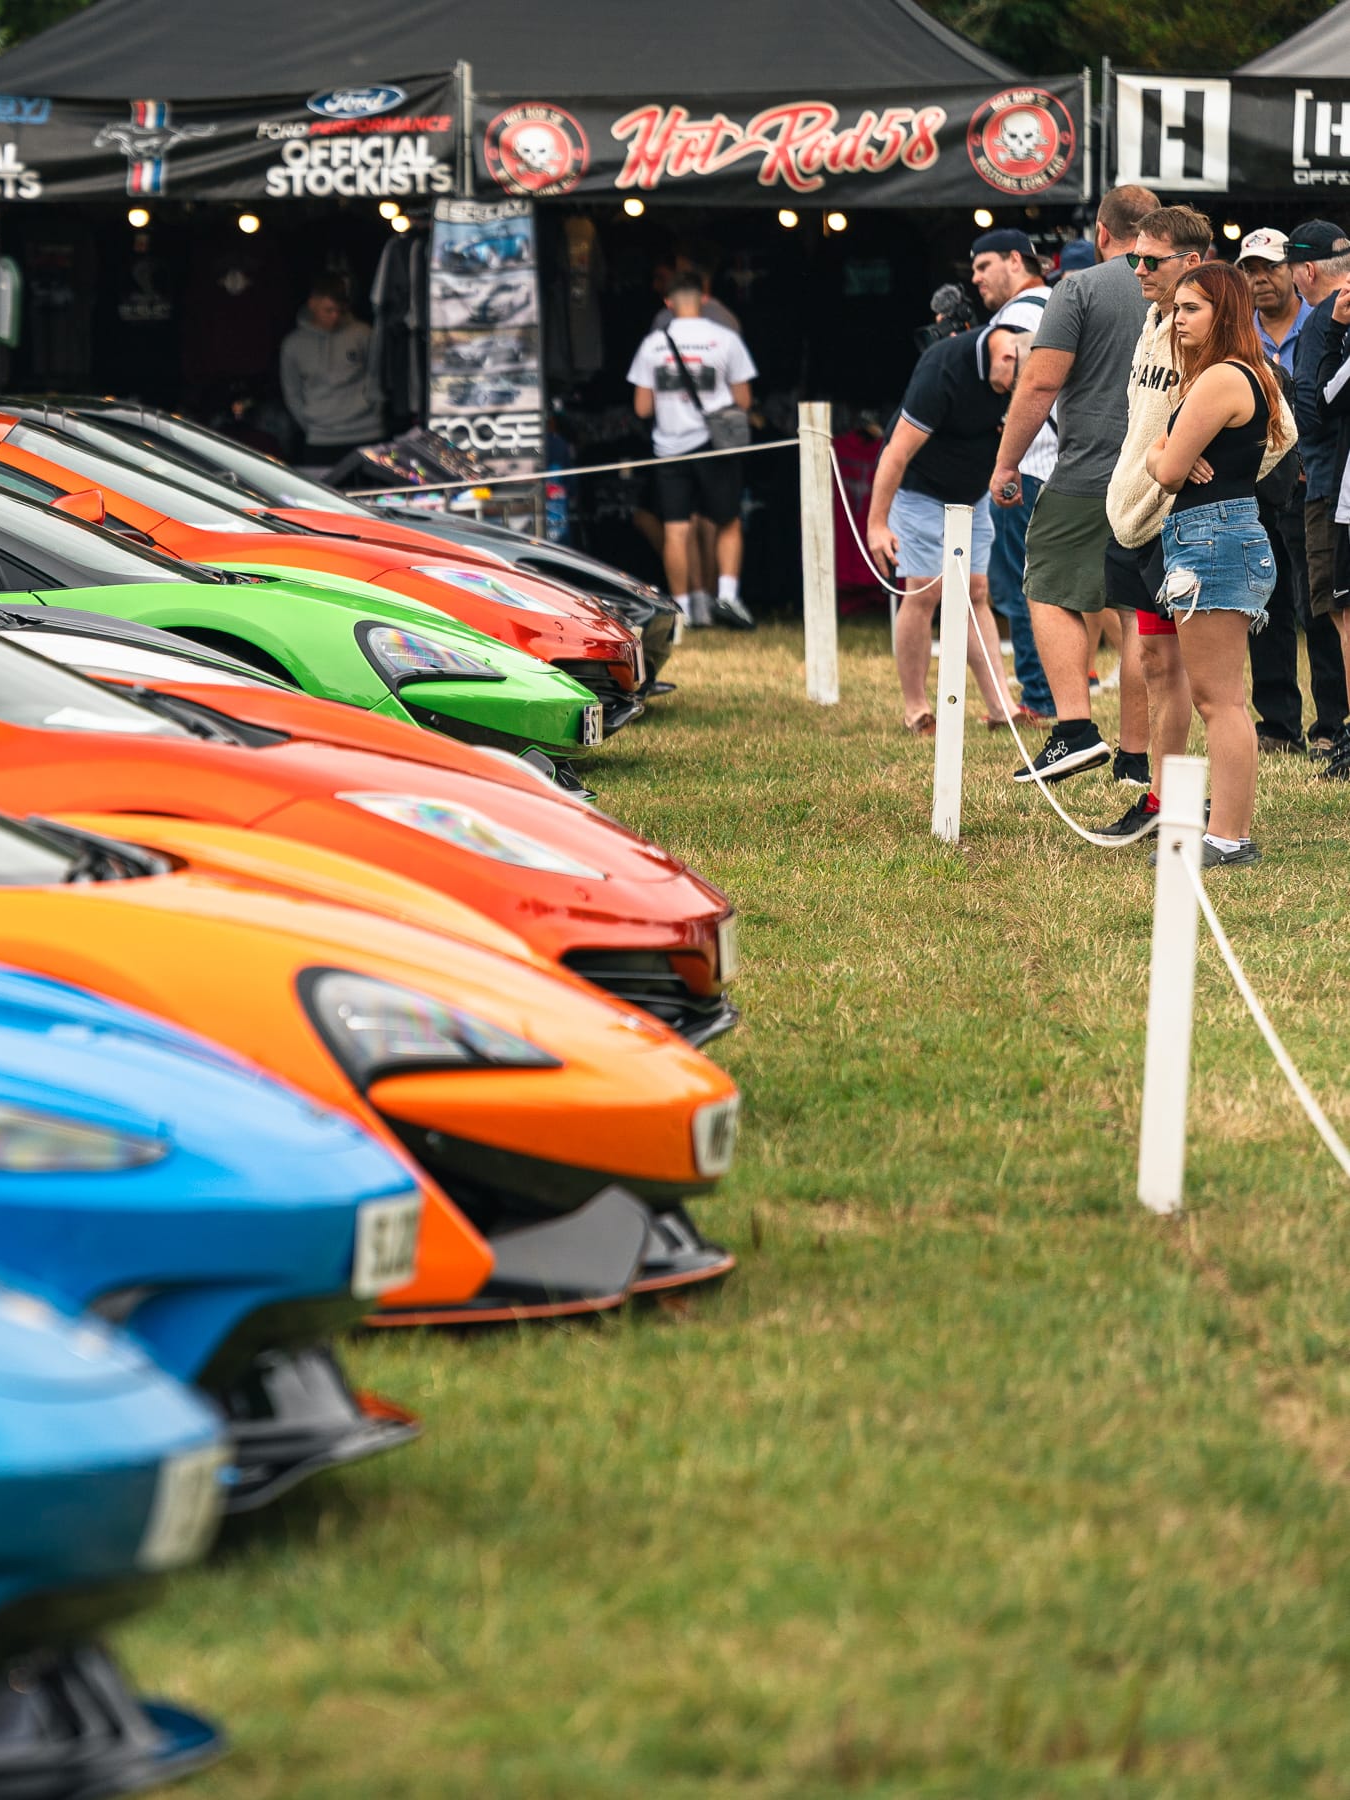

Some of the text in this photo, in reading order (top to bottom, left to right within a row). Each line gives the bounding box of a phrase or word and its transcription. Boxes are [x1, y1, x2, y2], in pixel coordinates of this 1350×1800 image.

[323, 88, 389, 112] Ford
[256, 115, 453, 139] FORD PERFORMANCE
[281, 136, 435, 169] OFFICIAL
[265, 164, 451, 197] STOCKISTS
